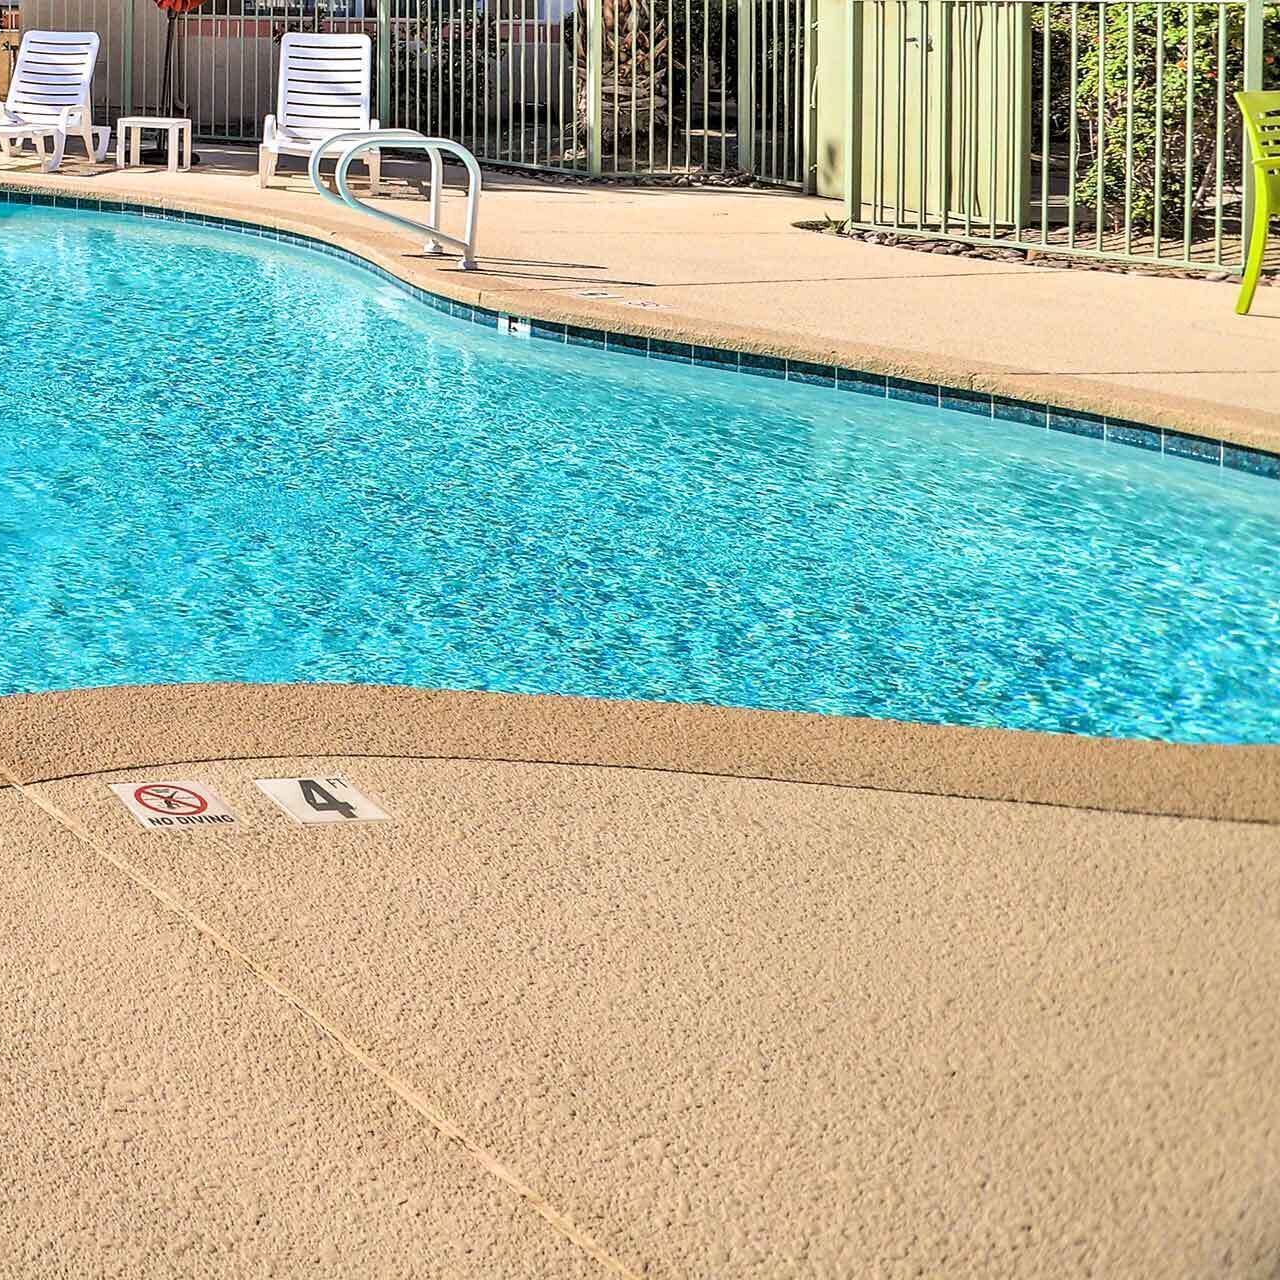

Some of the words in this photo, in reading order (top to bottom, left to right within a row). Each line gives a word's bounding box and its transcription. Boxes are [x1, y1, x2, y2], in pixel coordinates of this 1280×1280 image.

[326, 778, 348, 789] FT
[298, 779, 359, 818] 4
[148, 817, 174, 826] NO
[176, 814, 234, 825] DIVING
